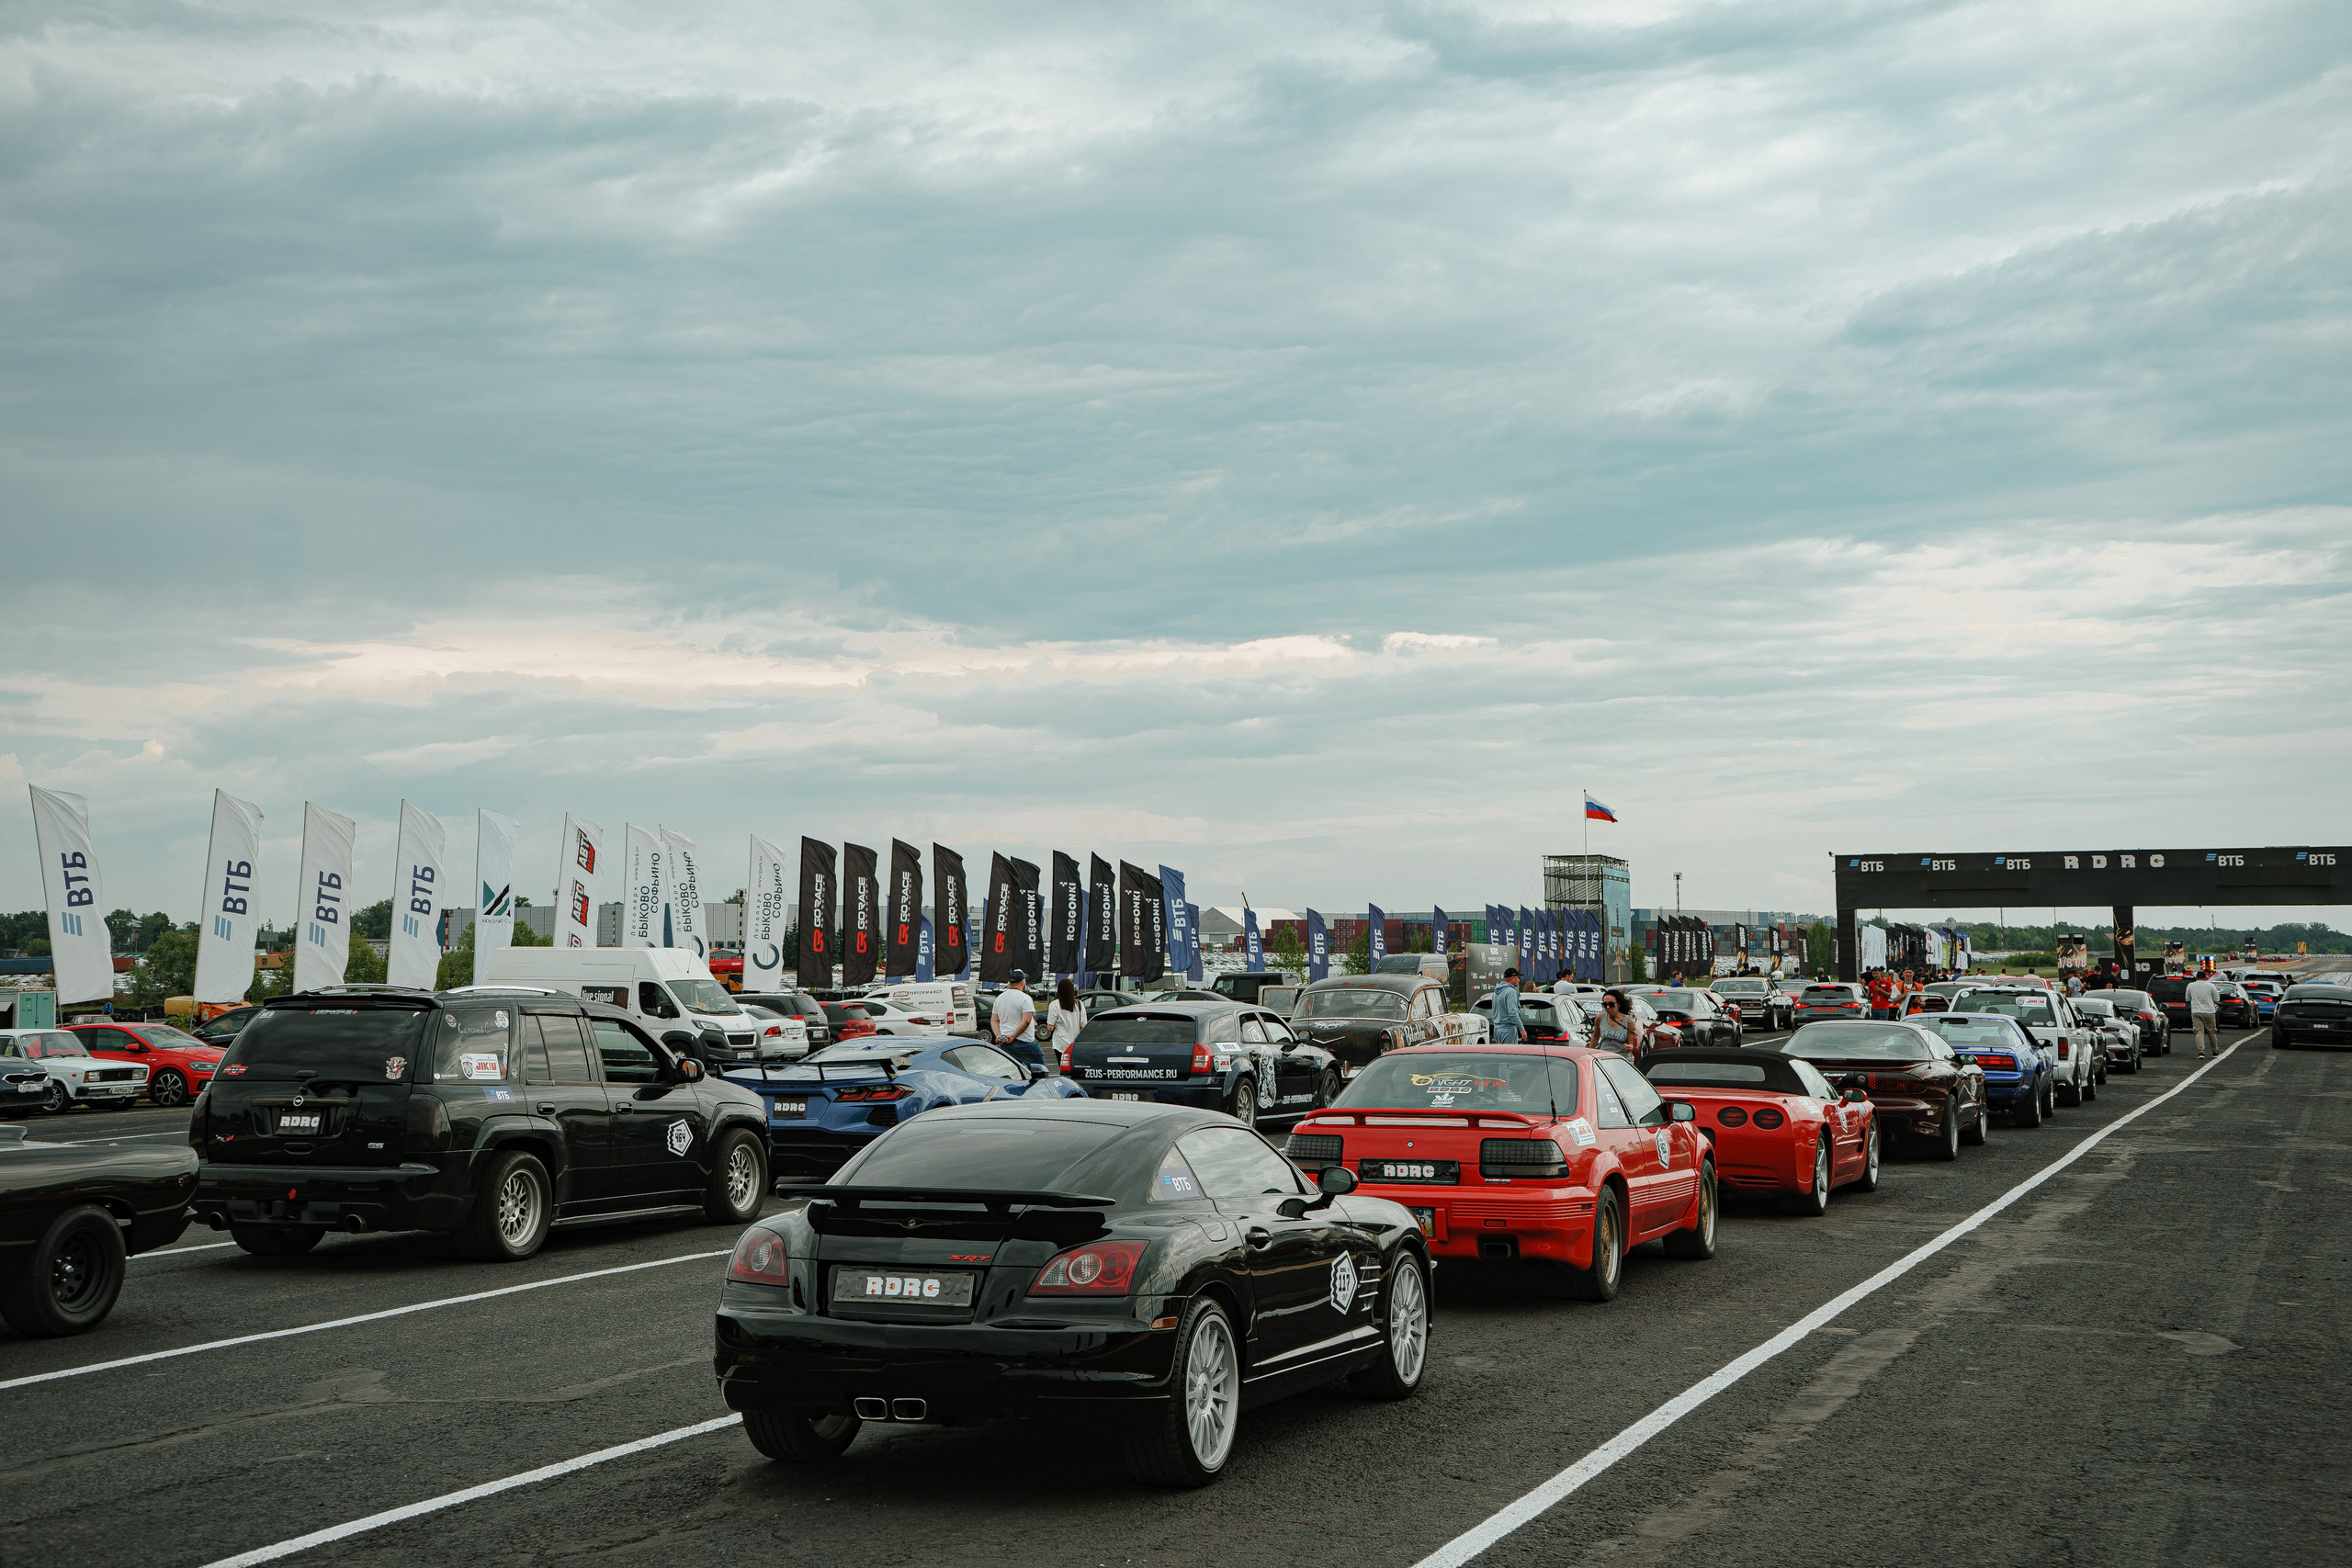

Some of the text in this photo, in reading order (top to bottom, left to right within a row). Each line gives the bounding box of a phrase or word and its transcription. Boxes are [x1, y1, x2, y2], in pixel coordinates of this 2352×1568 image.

[1860, 861, 1884, 873] ВТБ
[1932, 860, 1956, 871] ВТБ
[2007, 858, 2031, 870] ВТБ
[2218, 854, 2245, 867] ВТБ
[2309, 853, 2336, 866] ВТБ
[61, 851, 94, 908] ВТБ
[222, 860, 252, 915] ВТБ
[410, 864, 435, 915] ВТБ
[315, 871, 342, 923] ВТБ
[573, 883, 584, 921] АВТО
[679, 882, 692, 932] БЫКОВО
[814, 874, 823, 928] GORACE
[857, 876, 866, 930] GORACE
[899, 871, 910, 922] GORACE
[947, 874, 956, 924] GORACE
[997, 883, 1009, 931] GORACE
[581, 897, 589, 926] ПЛЮС
[639, 886, 650, 938] БЫКОВО
[761, 892, 773, 941] БЫКОВО
[1027, 889, 1036, 950] ROSGONKI
[1067, 882, 1077, 941] ROSGONKI
[1102, 884, 1111, 941] ROSGONKI
[1133, 890, 1141, 946] ROSGONKI
[1170, 897, 1187, 928] ВТБ
[1152, 898, 1161, 953] ROSGONKI
[920, 930, 930, 953] ВТБ
[1249, 931, 1259, 953] ВТБ
[1314, 932, 1325, 954] ВТБ
[1374, 929, 1385, 951] ВТБ
[1436, 931, 1445, 952] ВТБ
[1523, 928, 1532, 949] ВТБ
[1538, 931, 1546, 953] ВТБ
[1590, 931, 1600, 952] ВТБ
[1084, 1068, 1177, 1079] ZEUS-PERFORMANCE.RU
[495, 1090, 510, 1100] ВТБ
[775, 1102, 806, 1111] RDRC
[279, 1115, 320, 1128] RDRC
[674, 1133, 686, 1144] 464
[1383, 1164, 1435, 1179] RDRC
[1171, 1176, 1192, 1192] ВТБ
[947, 1254, 991, 1264] SRT
[865, 1275, 941, 1299] RDRC
[1338, 1273, 1351, 1292] 117
